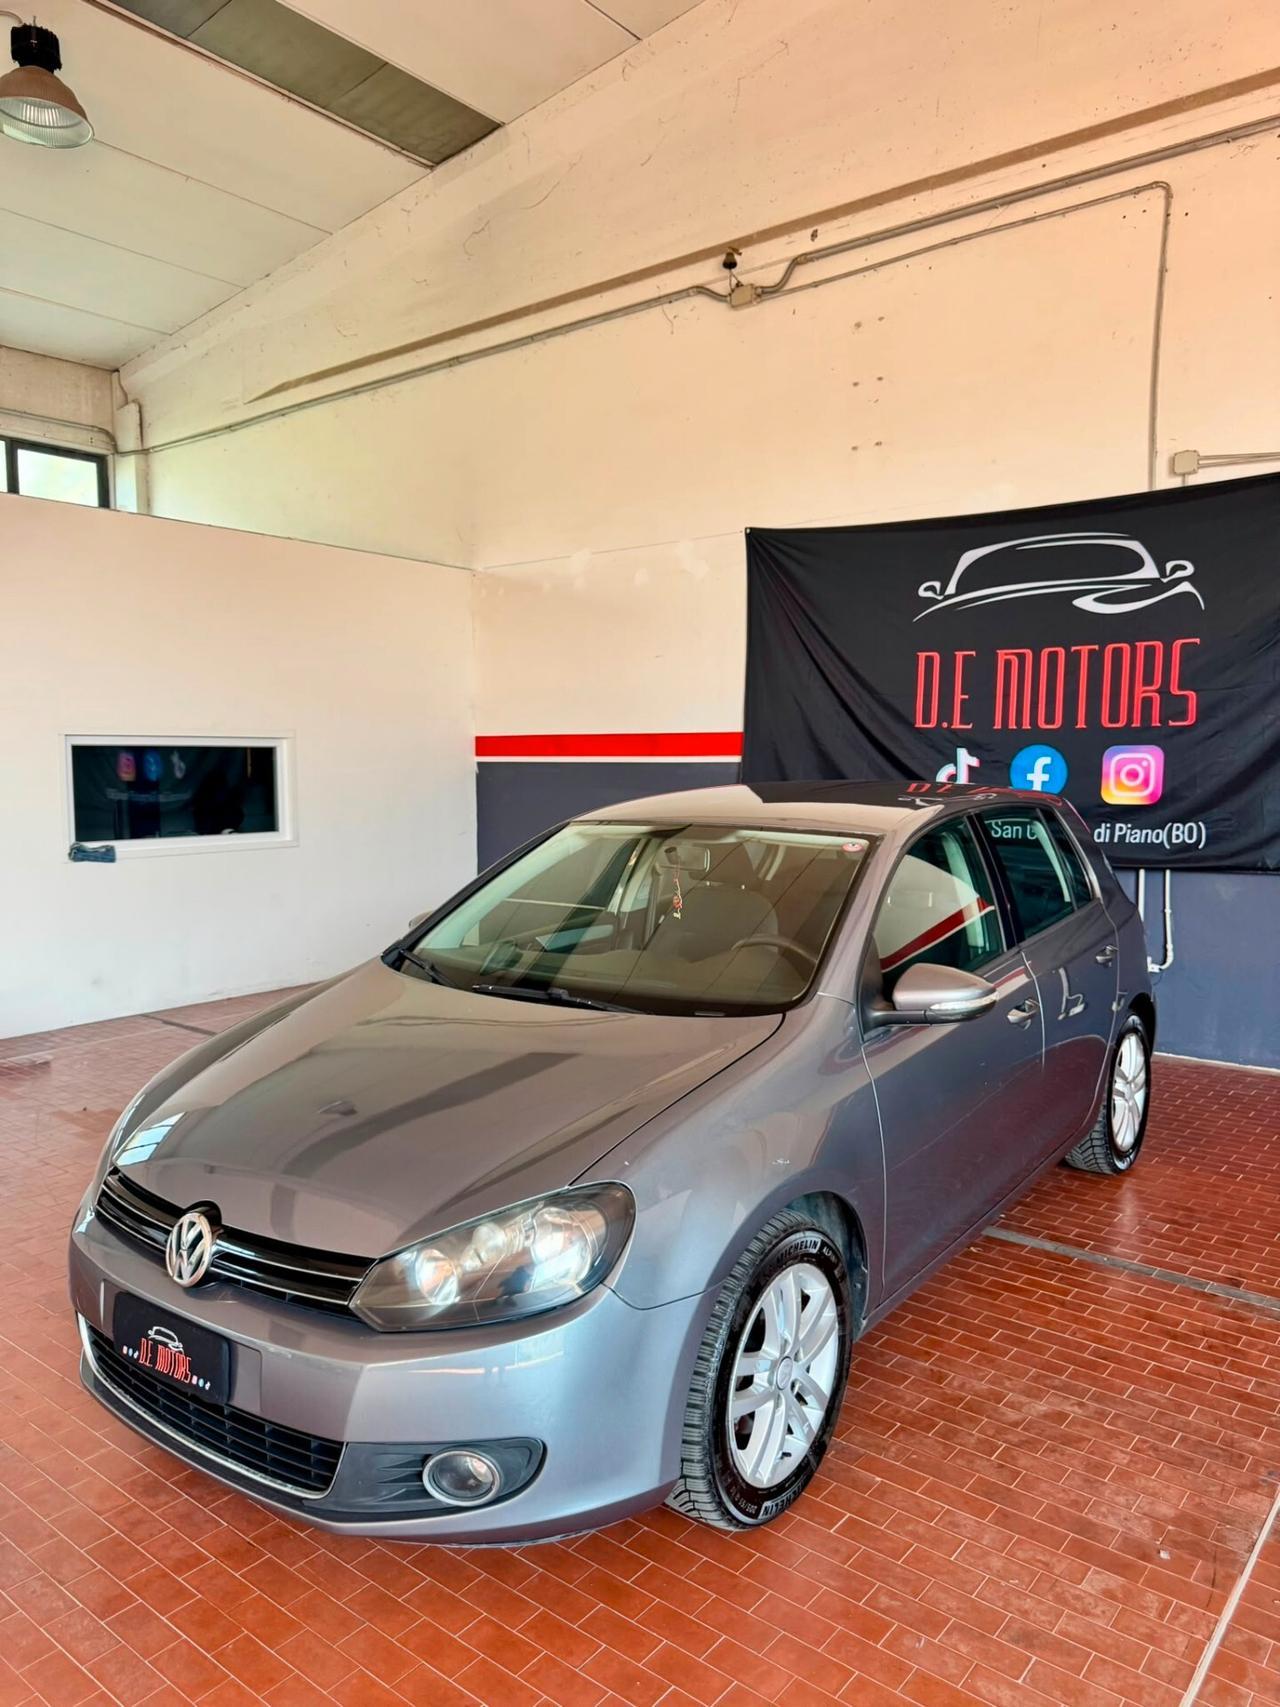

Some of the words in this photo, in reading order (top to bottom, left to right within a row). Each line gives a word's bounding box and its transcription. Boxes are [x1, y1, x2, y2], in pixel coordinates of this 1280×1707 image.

[914, 651, 976, 729] D.E
[993, 638, 1200, 729] MOTORS
[991, 820, 1023, 840] San
[1093, 823, 1111, 843] di
[1113, 821, 1206, 849] Piano(BO)
[776, 1239, 819, 1265] MICHELIN
[155, 1344, 192, 1383] MOTORS
